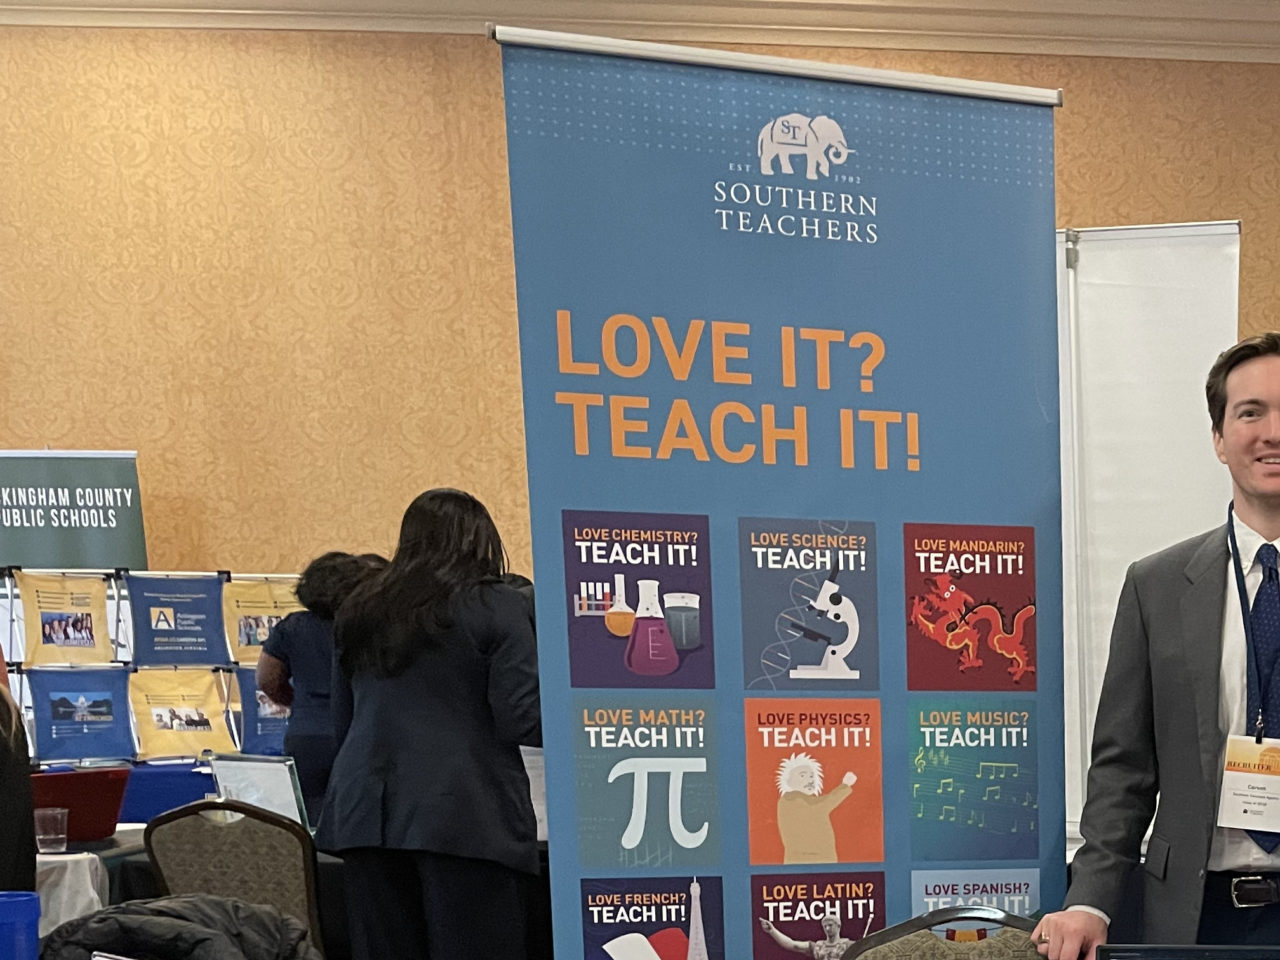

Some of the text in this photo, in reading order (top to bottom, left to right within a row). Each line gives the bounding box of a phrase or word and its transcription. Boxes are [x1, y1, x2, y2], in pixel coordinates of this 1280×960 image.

[781, 120, 800, 139] ST
[729, 162, 752, 173] EST
[714, 180, 877, 217] SOUTHERN
[714, 209, 878, 244] TEACHERS
[556, 309, 887, 392] LOVE IT?
[555, 392, 921, 471] TEACH IT!
[76, 488, 133, 507] COUNTY
[50, 508, 117, 528] SCHOOLS
[574, 527, 698, 544] LOVE CHEMISTRY?
[750, 532, 866, 549] LOVE SCIENCE?
[575, 541, 698, 567] TEACH IT!
[914, 539, 1025, 554] LOVE MANDARIN?
[752, 547, 867, 571] TEACH IT!
[915, 552, 1024, 575] TEACH IT!
[583, 709, 705, 726] LOVE MATH?
[757, 712, 871, 727] LOVE PHYSICS?
[919, 711, 1029, 726] LOVE MUSIC?
[584, 727, 704, 748] TEACH IT!
[758, 727, 871, 748] TEACH IT!
[920, 726, 1028, 748] TEACH IT!
[762, 882, 874, 901] LOVE LATIN?
[925, 882, 1030, 896] LOVE SPANISH?
[588, 892, 687, 906] LOVE FRENCH?
[589, 905, 686, 924] TEACH IT!
[763, 899, 875, 922] TEACH IT!
